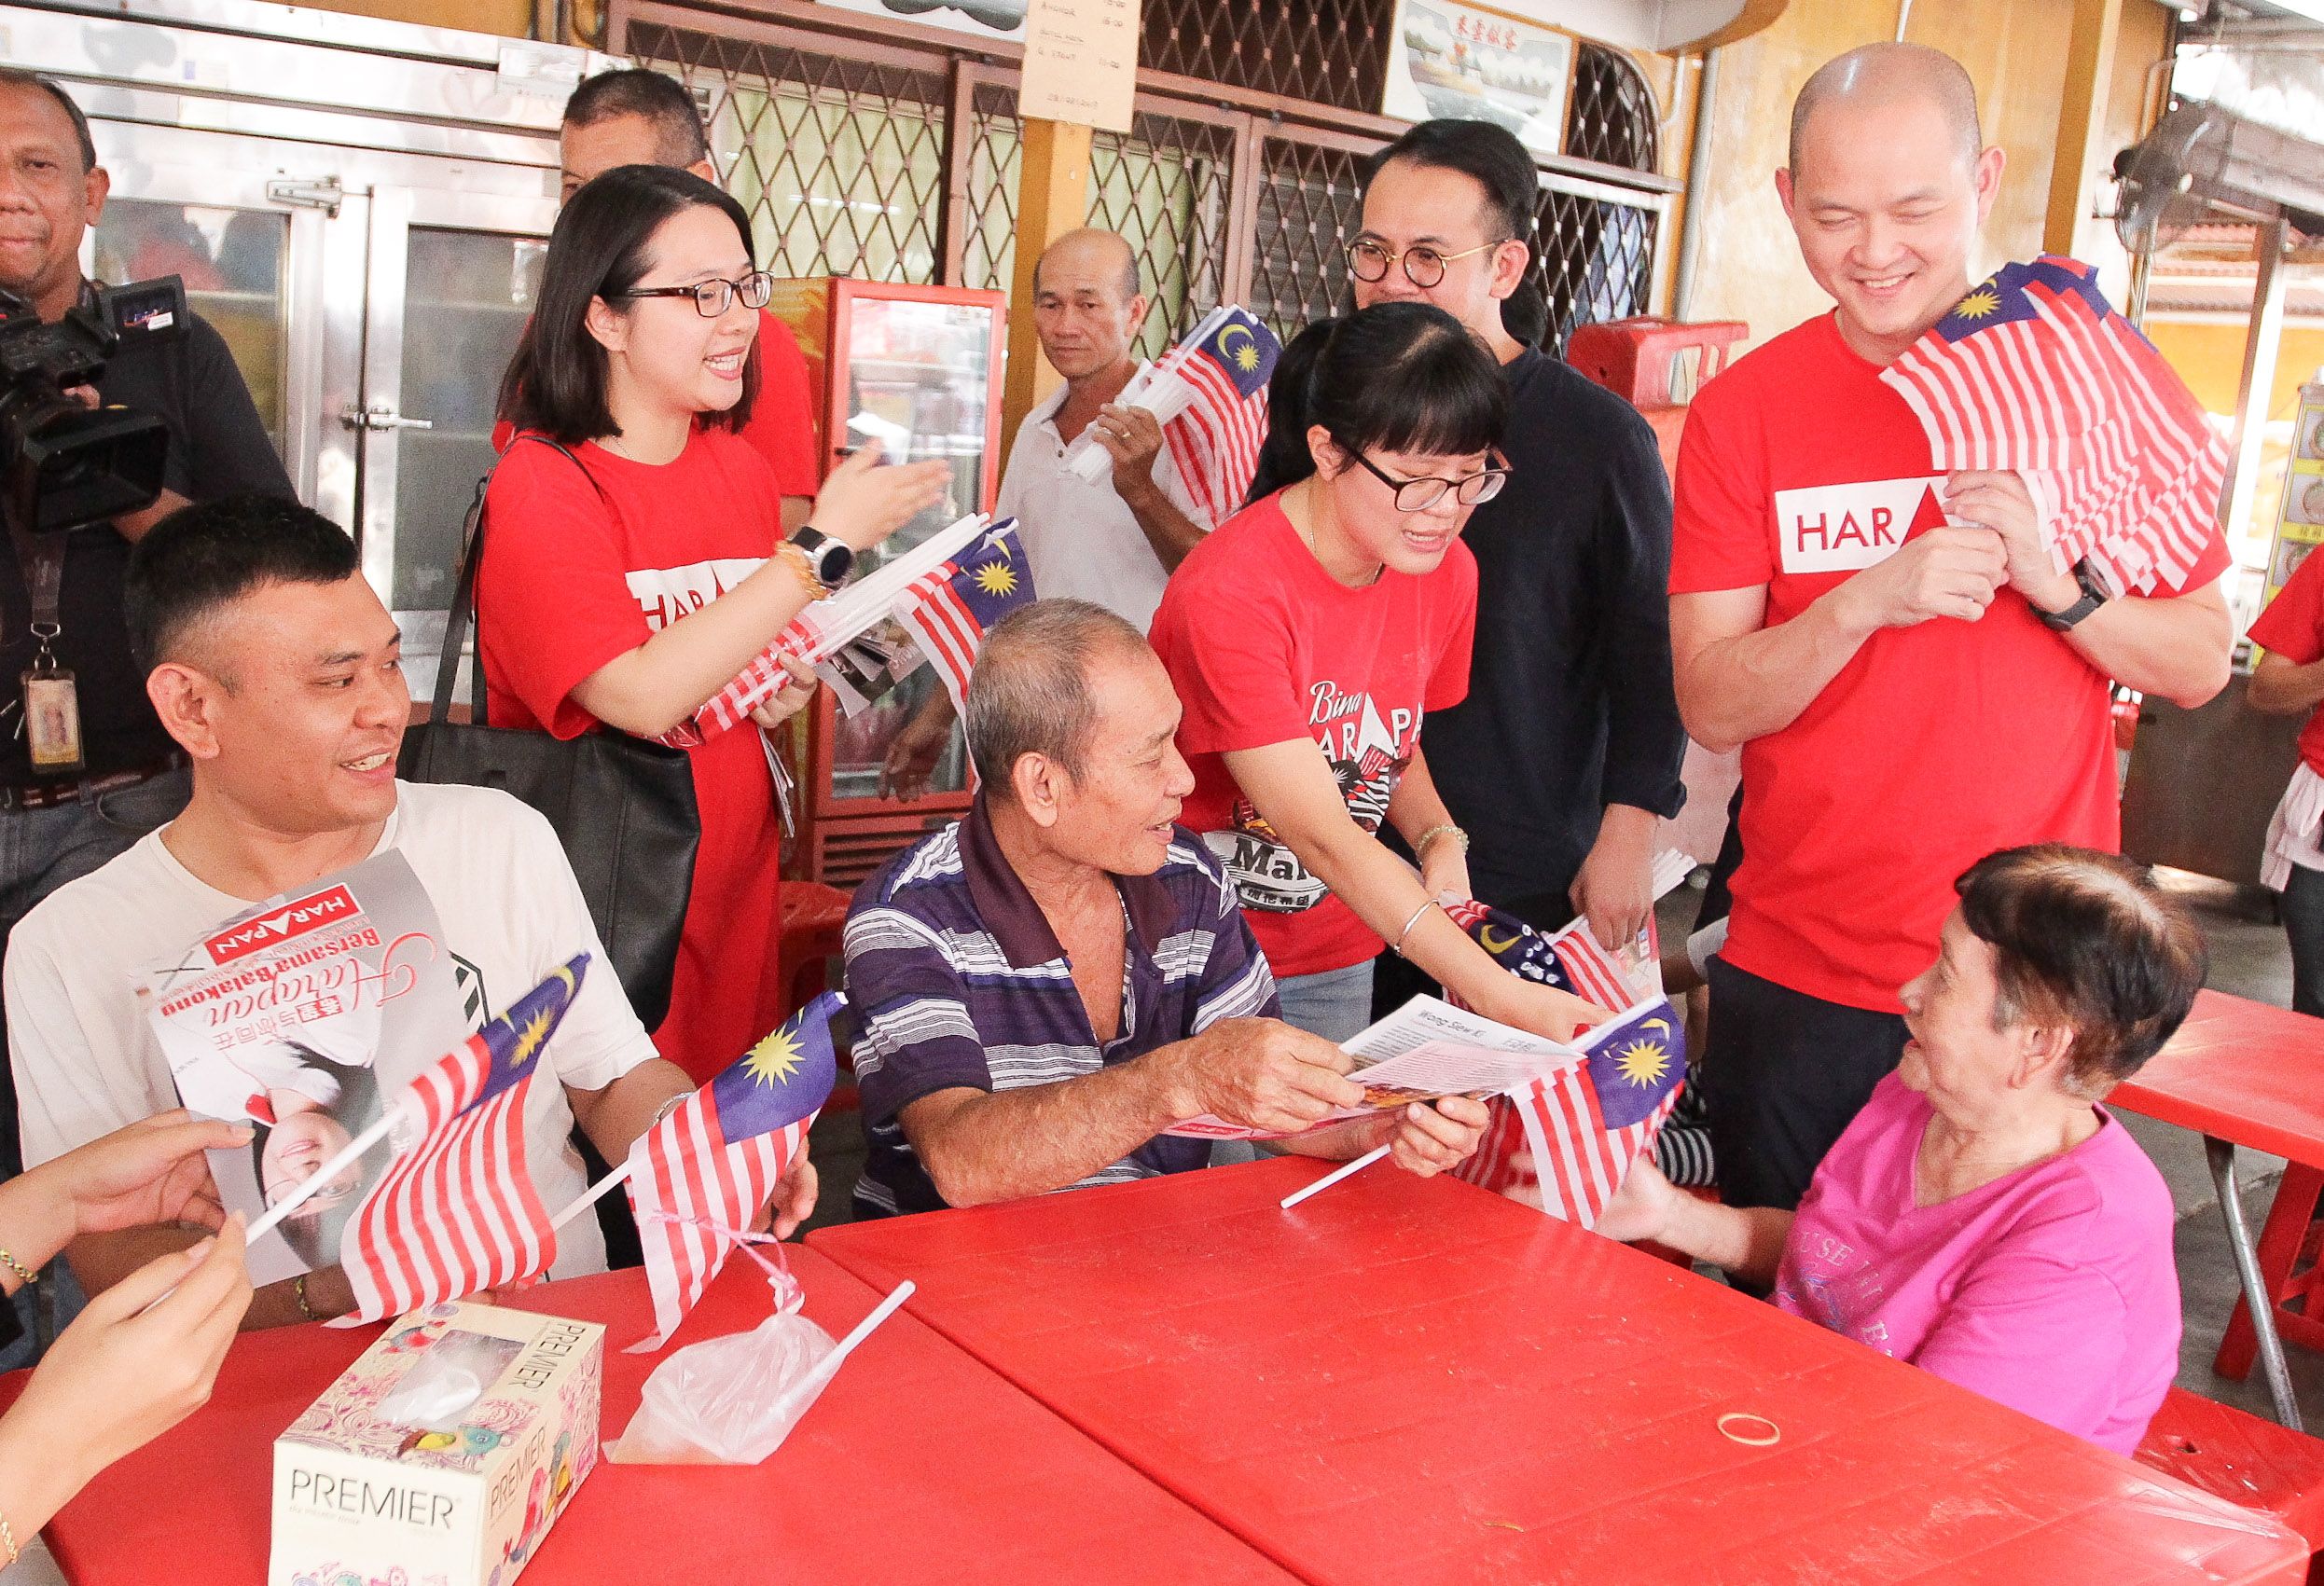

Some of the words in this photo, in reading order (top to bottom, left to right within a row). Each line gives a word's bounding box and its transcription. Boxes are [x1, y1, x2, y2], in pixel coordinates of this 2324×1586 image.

[209, 932, 436, 1027] Harapan
[276, 927, 382, 972] Bersama
[508, 1323, 585, 1389] PREMIER
[289, 1469, 454, 1529] PREMIER
[489, 1426, 546, 1519] PREMIER
